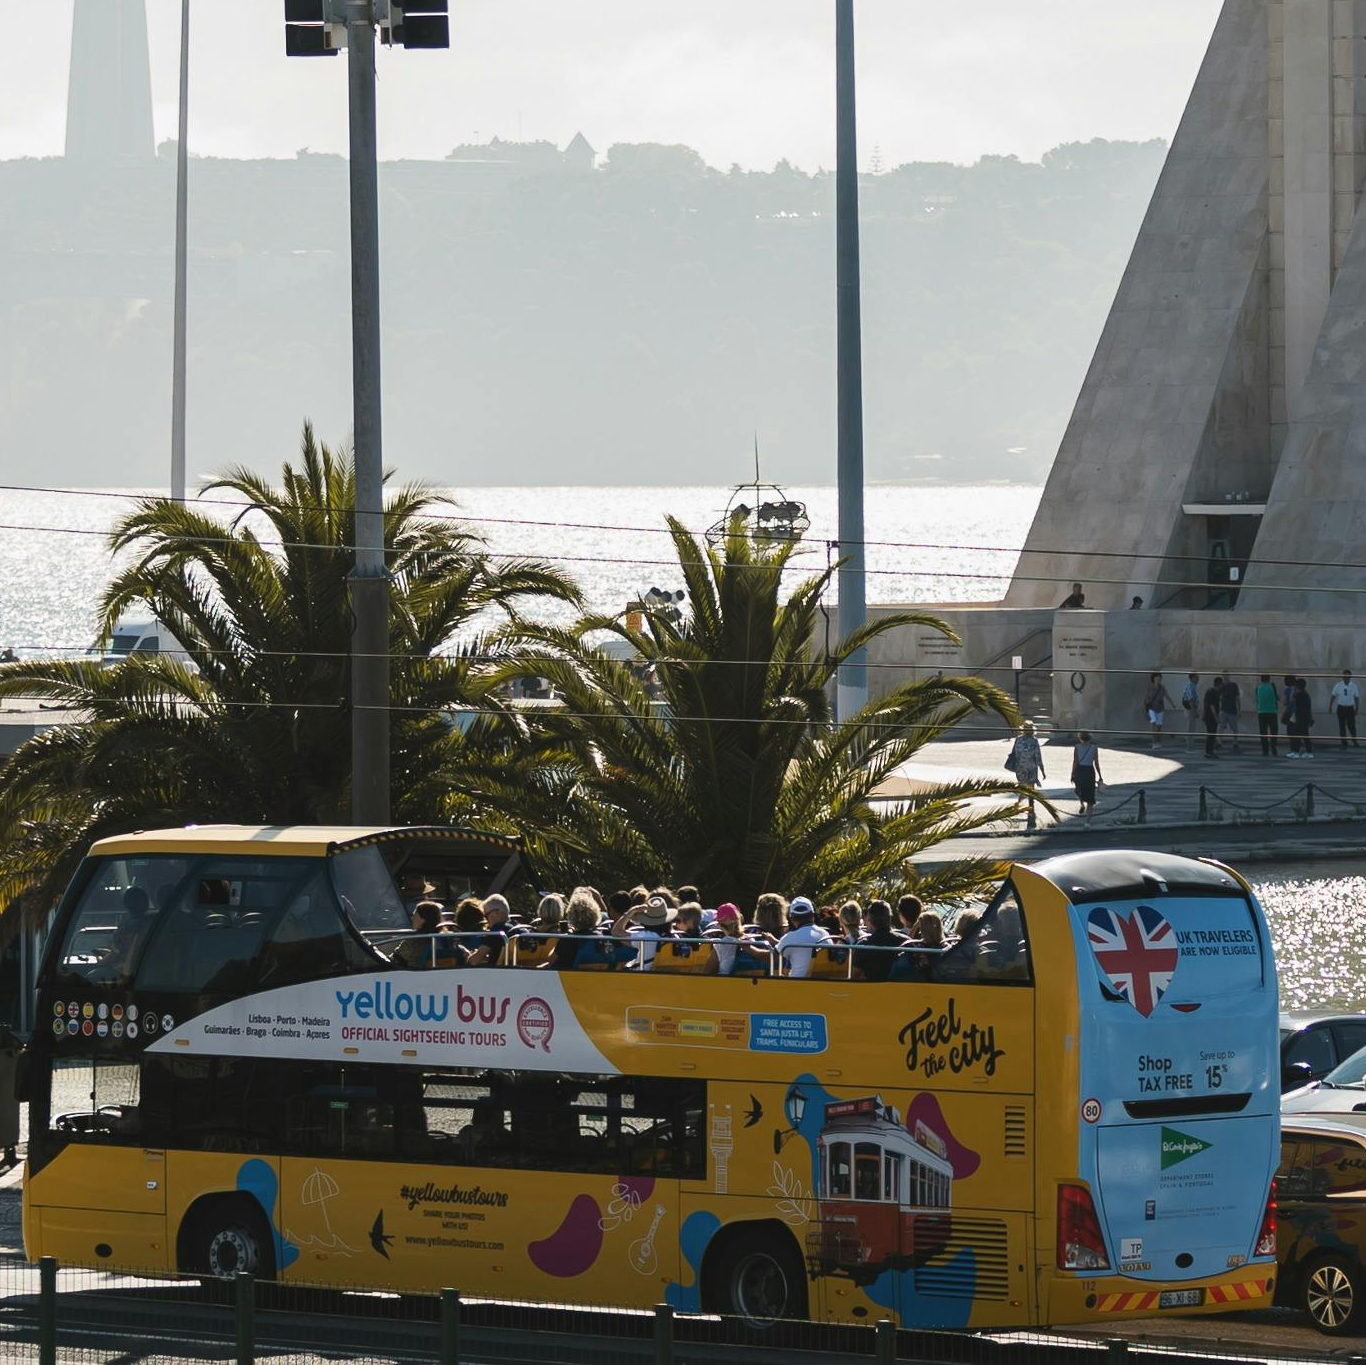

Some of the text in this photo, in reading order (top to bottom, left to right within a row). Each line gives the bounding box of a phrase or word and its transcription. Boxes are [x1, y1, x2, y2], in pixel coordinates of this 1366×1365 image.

[1175, 930, 1254, 944] UK TRAVELERS
[1180, 945, 1257, 956] ARE NOW ELIGIBLE
[457, 984, 511, 1025] bus
[248, 1014, 330, 1026] Lisboa Porto Madeira
[763, 1019, 811, 1029] FREE ACCESS TO
[204, 1024, 330, 1040] Guimarães Braga Coimbra Açores
[341, 1026, 507, 1046] OFFICIAL SIGHTSEEING TOURS
[760, 1028, 780, 1037] SANTA
[781, 1029, 799, 1038] JUSTA
[898, 997, 961, 1071] Feel
[780, 1038, 818, 1048] FUNICULARS
[920, 1024, 1005, 1078] the city
[1199, 1050, 1236, 1061] Save up to
[1138, 1055, 1172, 1073] Shop
[1138, 1074, 1193, 1092] TAX FREE
[1085, 1105, 1098, 1117] 80
[400, 1182, 509, 1211] #yellowbustours
[405, 1236, 504, 1250] www.yellowbustours.com
[1130, 1243, 1142, 1254] TP
[1081, 1281, 1096, 1291] 112
